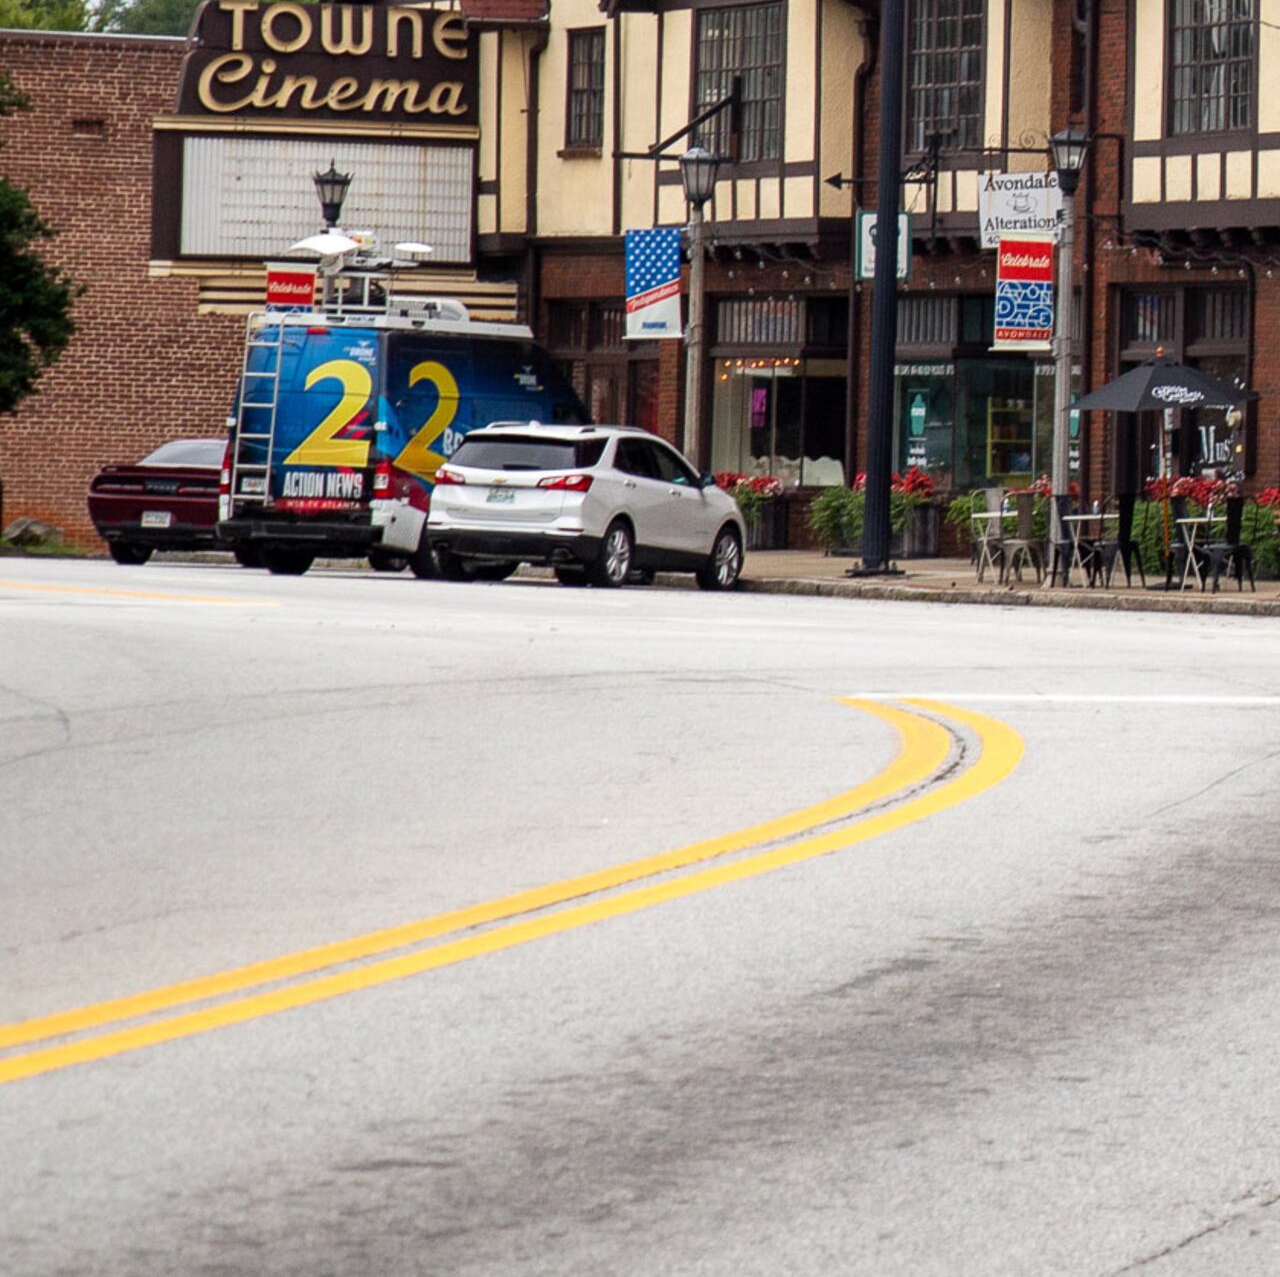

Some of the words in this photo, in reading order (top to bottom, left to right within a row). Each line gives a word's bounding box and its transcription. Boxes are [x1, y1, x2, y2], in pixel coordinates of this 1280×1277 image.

[198, 52, 469, 115] Cinema
[984, 174, 1058, 192] Avondale
[984, 215, 1059, 231] Alteration
[1001, 252, 1050, 268] Celebrate
[283, 359, 373, 467] 2
[391, 360, 461, 484] 2
[283, 471, 324, 497] ACTION
[325, 472, 364, 498] NEWS
